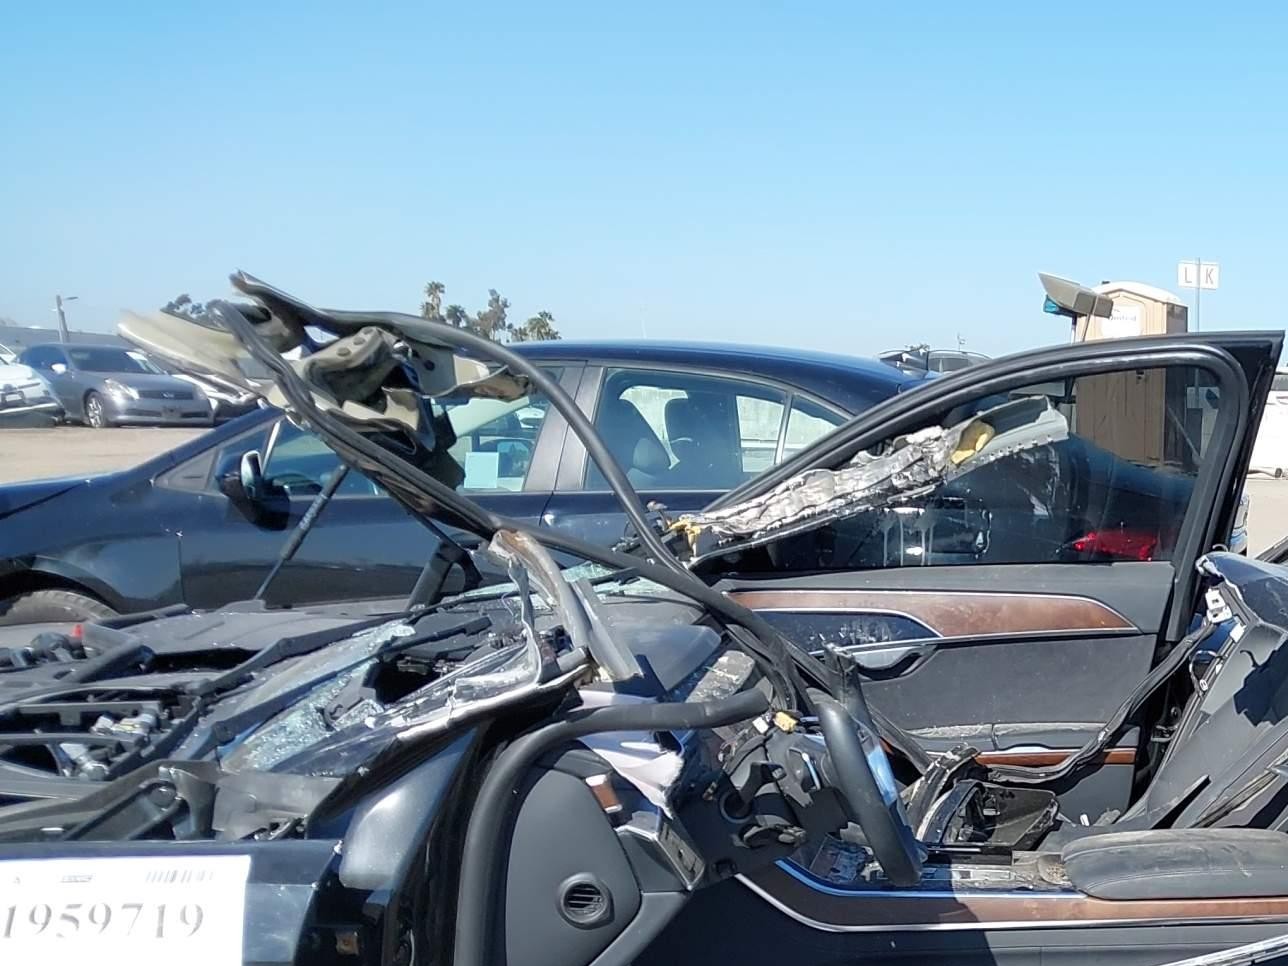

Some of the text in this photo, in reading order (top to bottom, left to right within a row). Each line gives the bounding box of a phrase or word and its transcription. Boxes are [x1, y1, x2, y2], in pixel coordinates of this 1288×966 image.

[1184, 266, 1193, 284] L
[1205, 266, 1215, 285] K
[3, 903, 204, 939] 1959719
